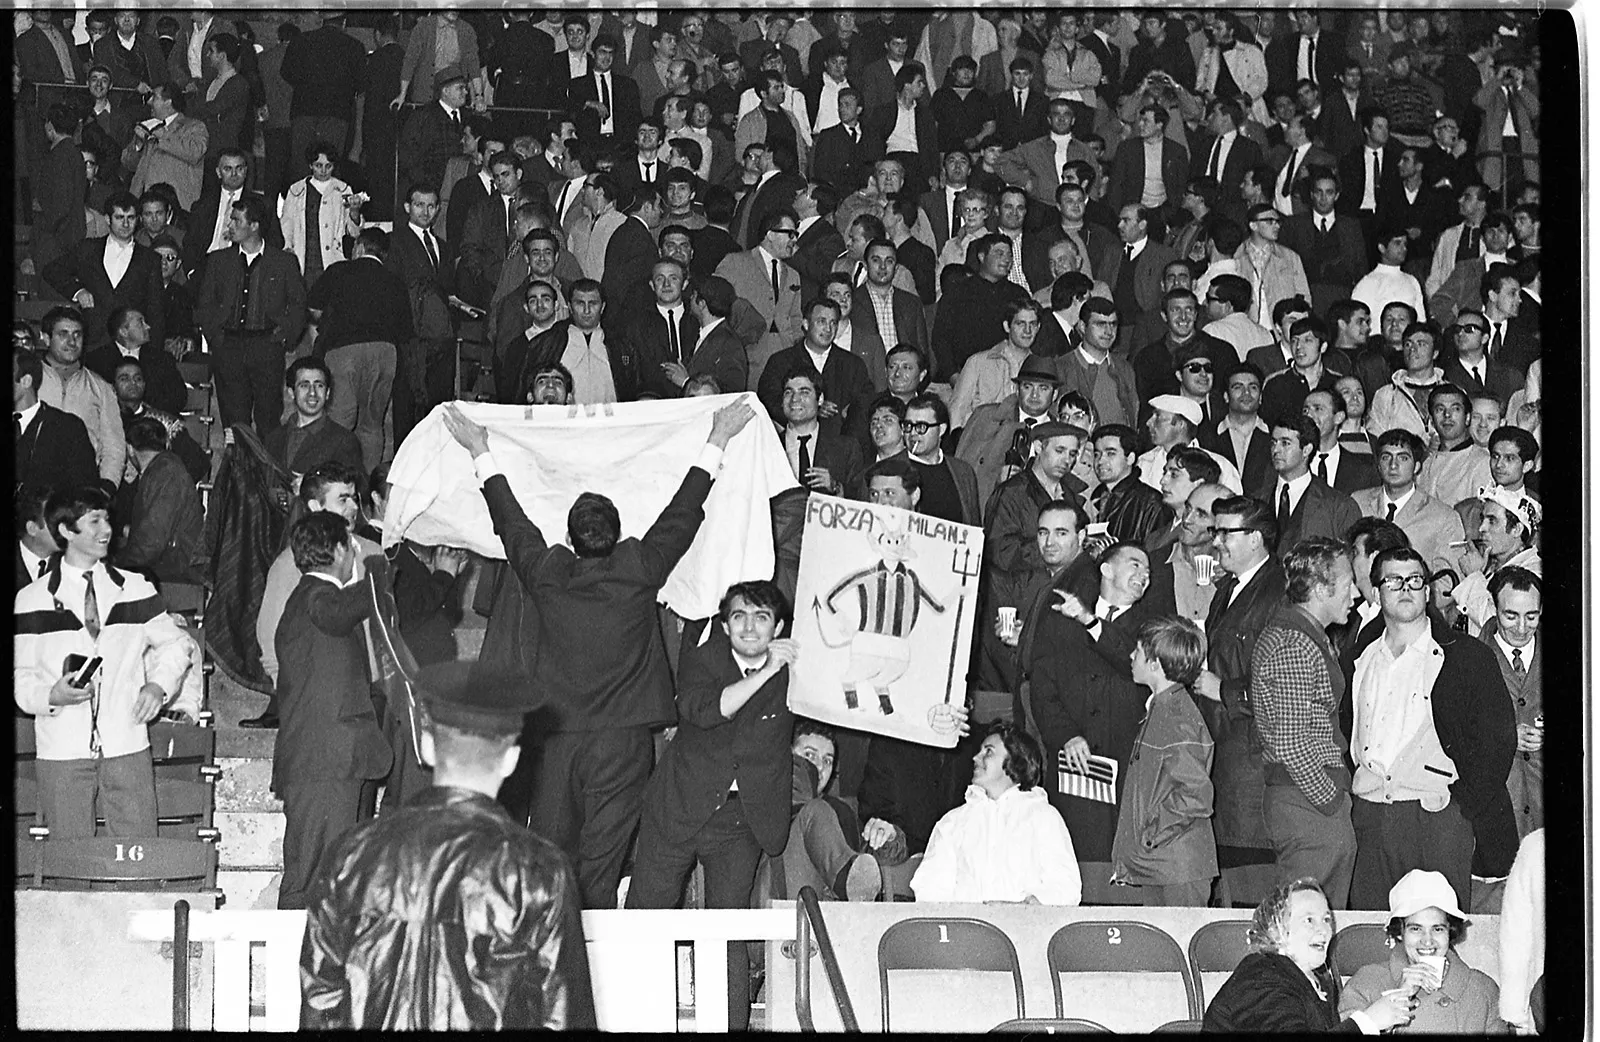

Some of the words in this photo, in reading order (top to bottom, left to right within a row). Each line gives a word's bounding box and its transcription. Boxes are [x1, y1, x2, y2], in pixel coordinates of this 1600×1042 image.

[807, 499, 874, 532] FORZA
[115, 844, 144, 861] 16
[938, 924, 950, 943] 1
[1107, 927, 1122, 944] 2
